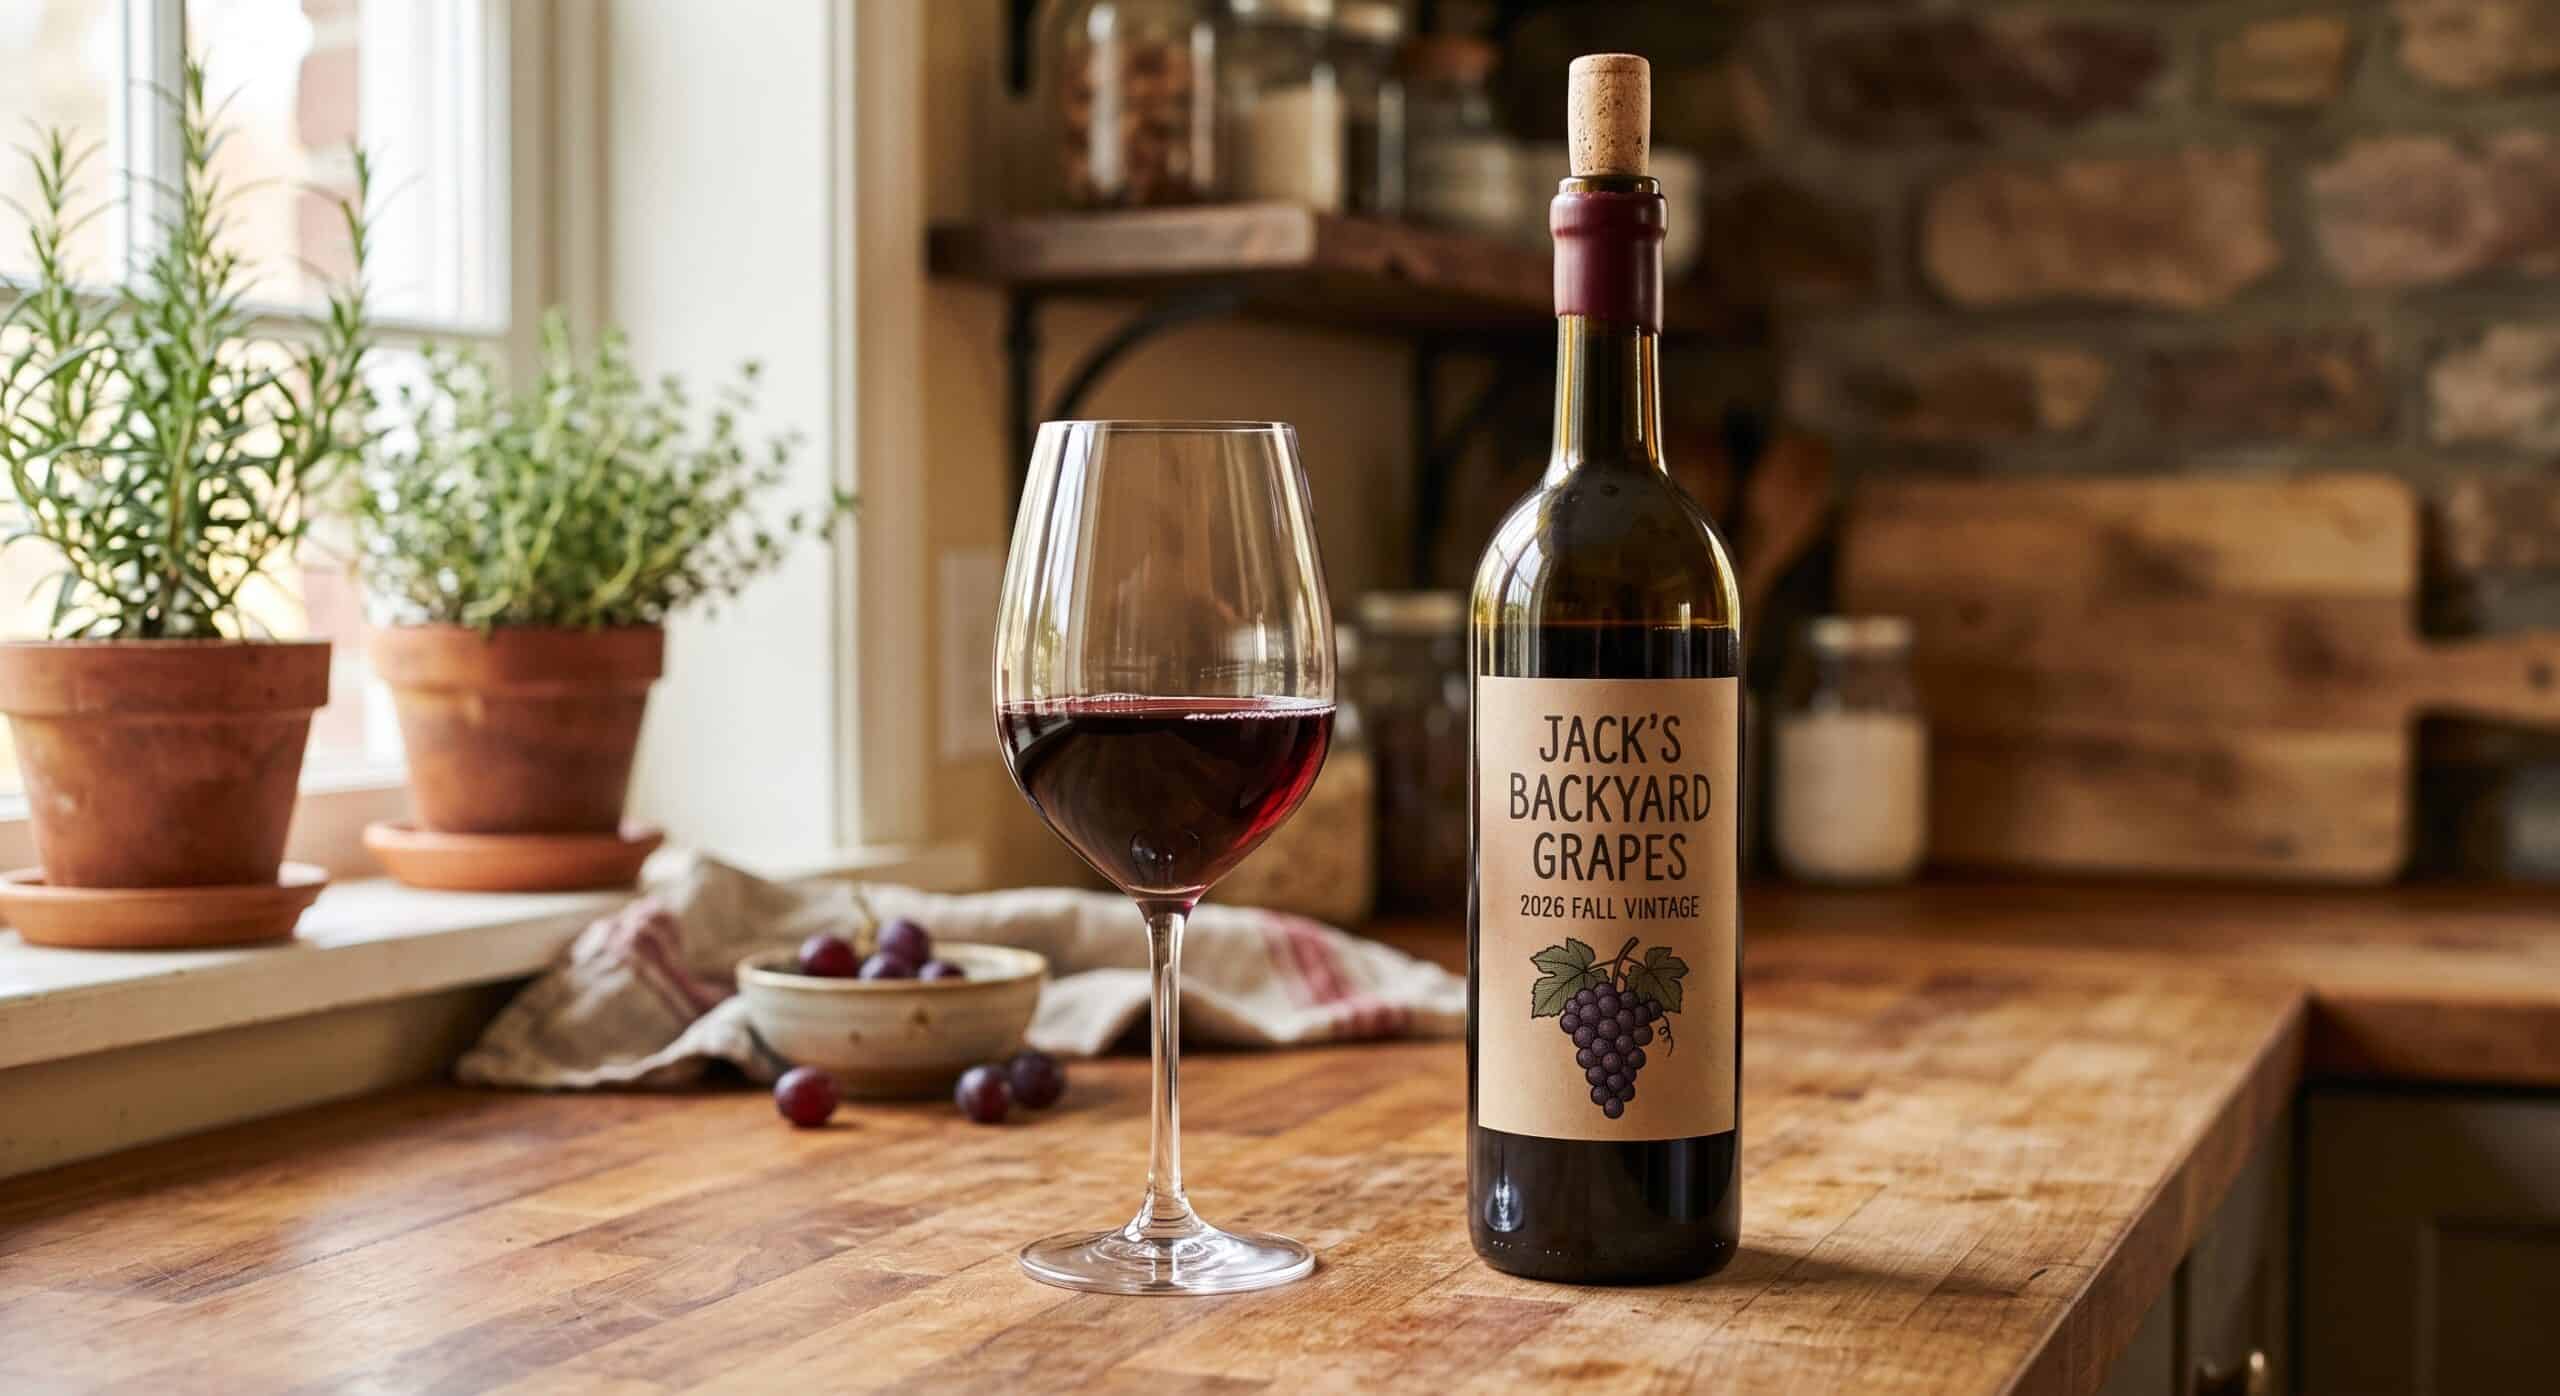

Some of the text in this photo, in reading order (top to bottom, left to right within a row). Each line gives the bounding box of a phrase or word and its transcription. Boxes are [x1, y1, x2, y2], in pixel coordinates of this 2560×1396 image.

[1539, 713, 1682, 764] JACK'S
[1510, 772, 1712, 823] BACKYARD
[1532, 832, 1688, 882] GRAPES
[1520, 895, 1700, 920] 2026 FALL VINTAGE
